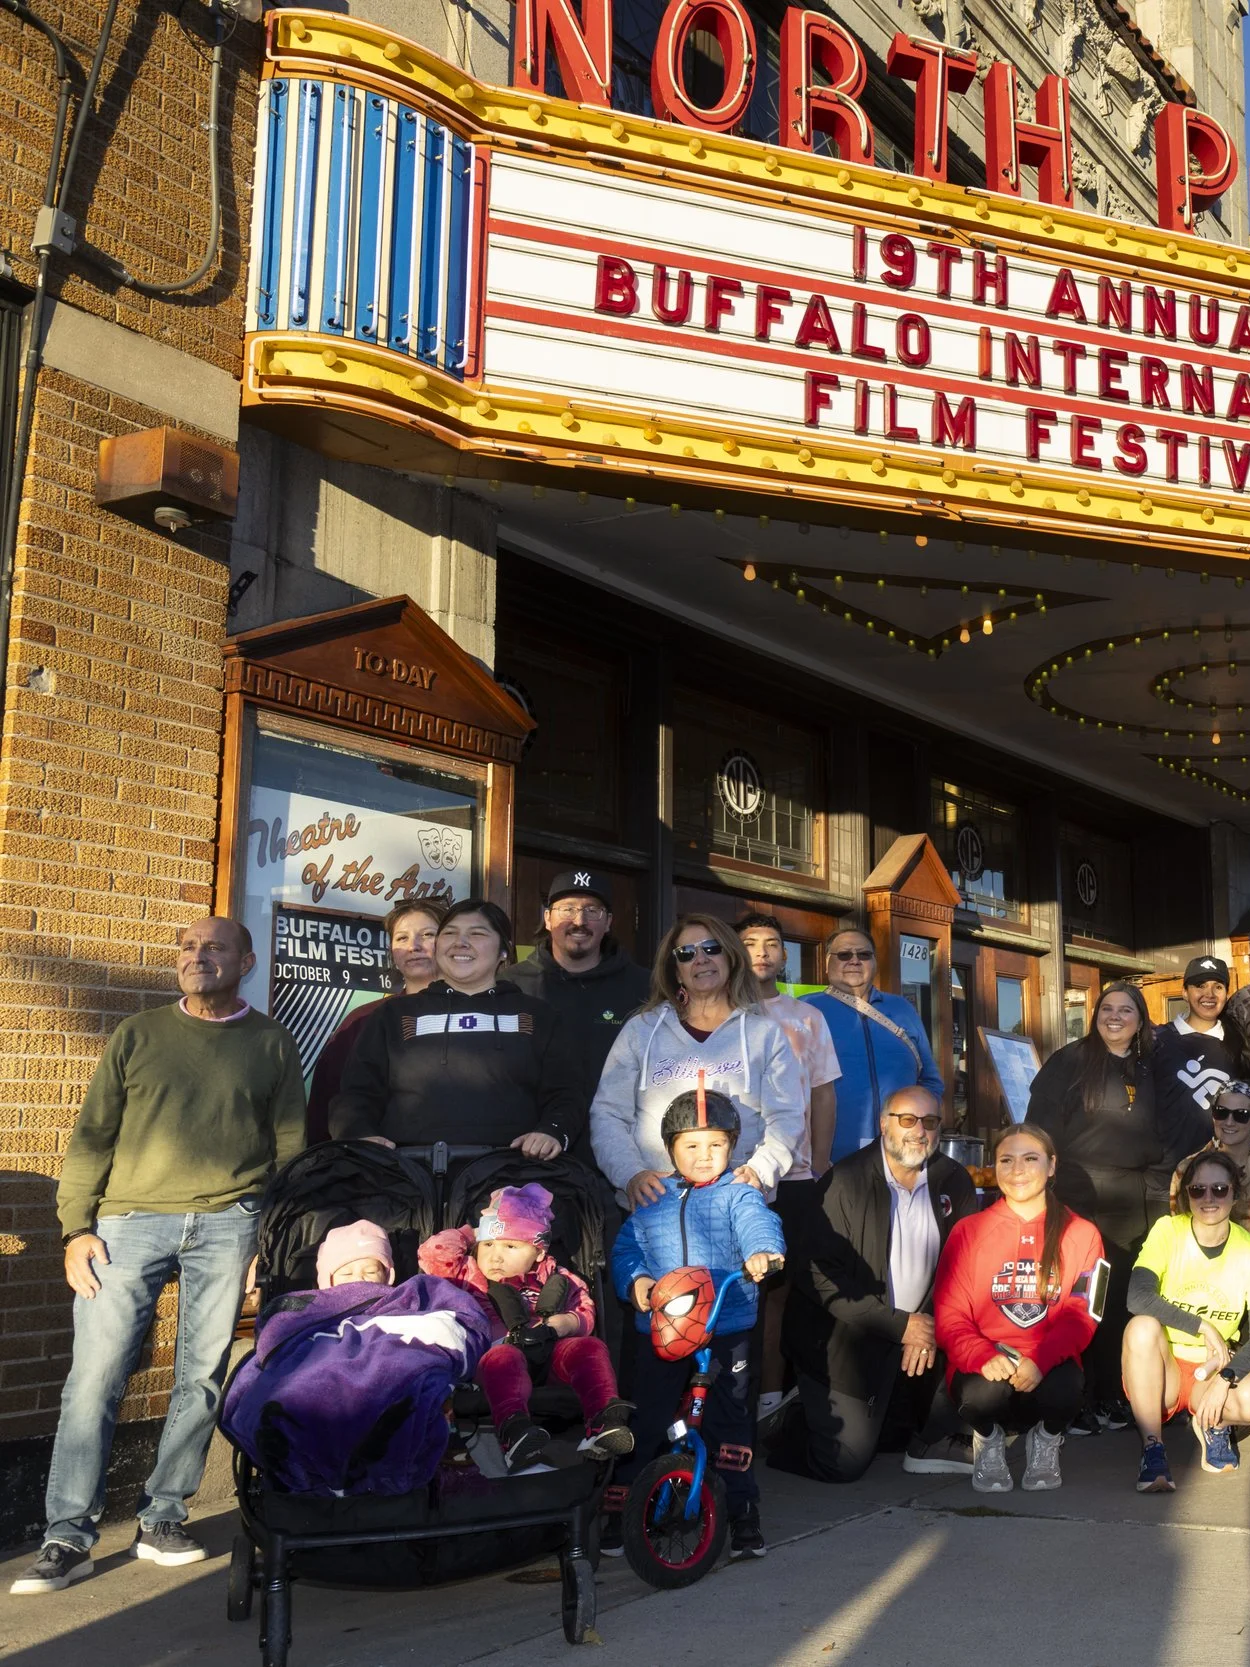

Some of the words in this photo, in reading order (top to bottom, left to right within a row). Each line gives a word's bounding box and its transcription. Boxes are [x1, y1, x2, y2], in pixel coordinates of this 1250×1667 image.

[512, 0, 1073, 207] NORTH
[852, 225, 1009, 310] 19TH
[594, 254, 930, 369] BUFFALO
[804, 370, 977, 452] FILM
[247, 811, 362, 868] Theatre
[301, 854, 334, 903] of
[332, 855, 385, 896] the
[574, 872, 591, 887] NY
[275, 916, 372, 946] BUFFALO
[275, 937, 328, 961] FILM
[902, 943, 928, 960] 1428
[274, 962, 331, 982] OCTOBER
[342, 969, 350, 984] 9
[379, 974, 392, 989] 16
[1209, 1310, 1240, 1321] FEET
